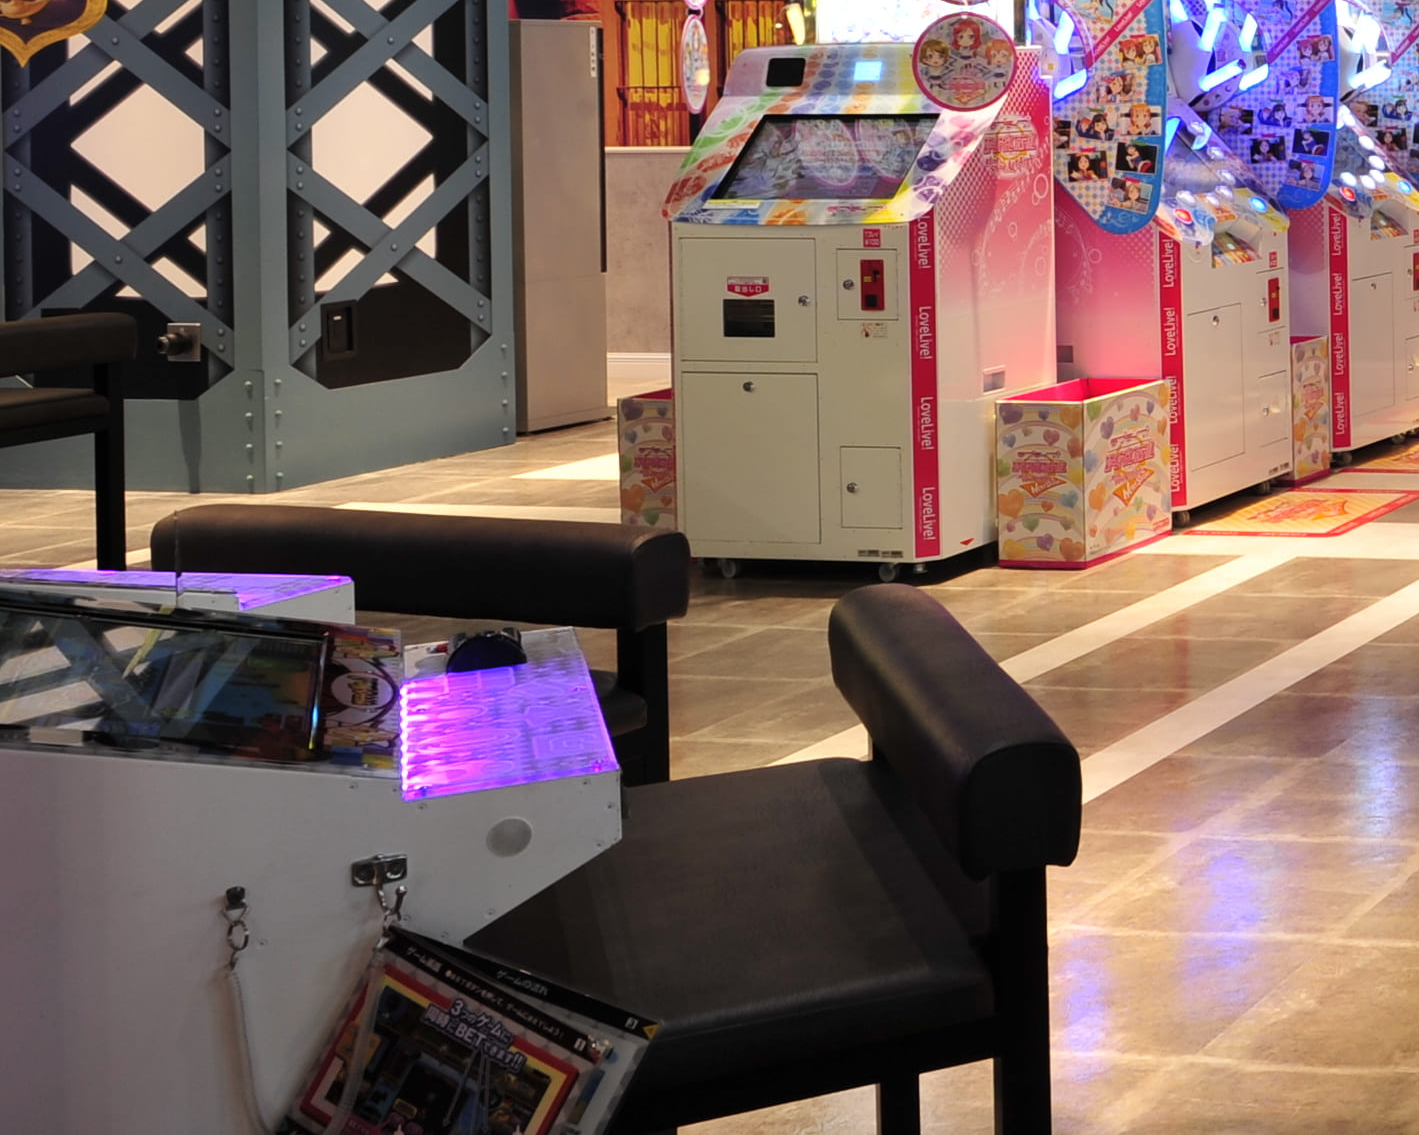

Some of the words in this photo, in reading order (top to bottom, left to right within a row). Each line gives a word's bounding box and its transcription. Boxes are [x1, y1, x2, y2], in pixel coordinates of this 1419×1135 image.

[916, 214, 931, 269] LoveLive!
[1332, 213, 1341, 256] LoveLive!
[1163, 239, 1175, 288] LoveLive!
[1334, 273, 1343, 316] LoveLive!
[919, 305, 933, 360] LoveLive!
[1165, 307, 1177, 356] LoveLive!
[1335, 333, 1344, 376] LoveLive!
[921, 396, 935, 451] LoveLive!
[1336, 392, 1346, 435] LoveLive!
[922, 486, 937, 541] LoveLive!
